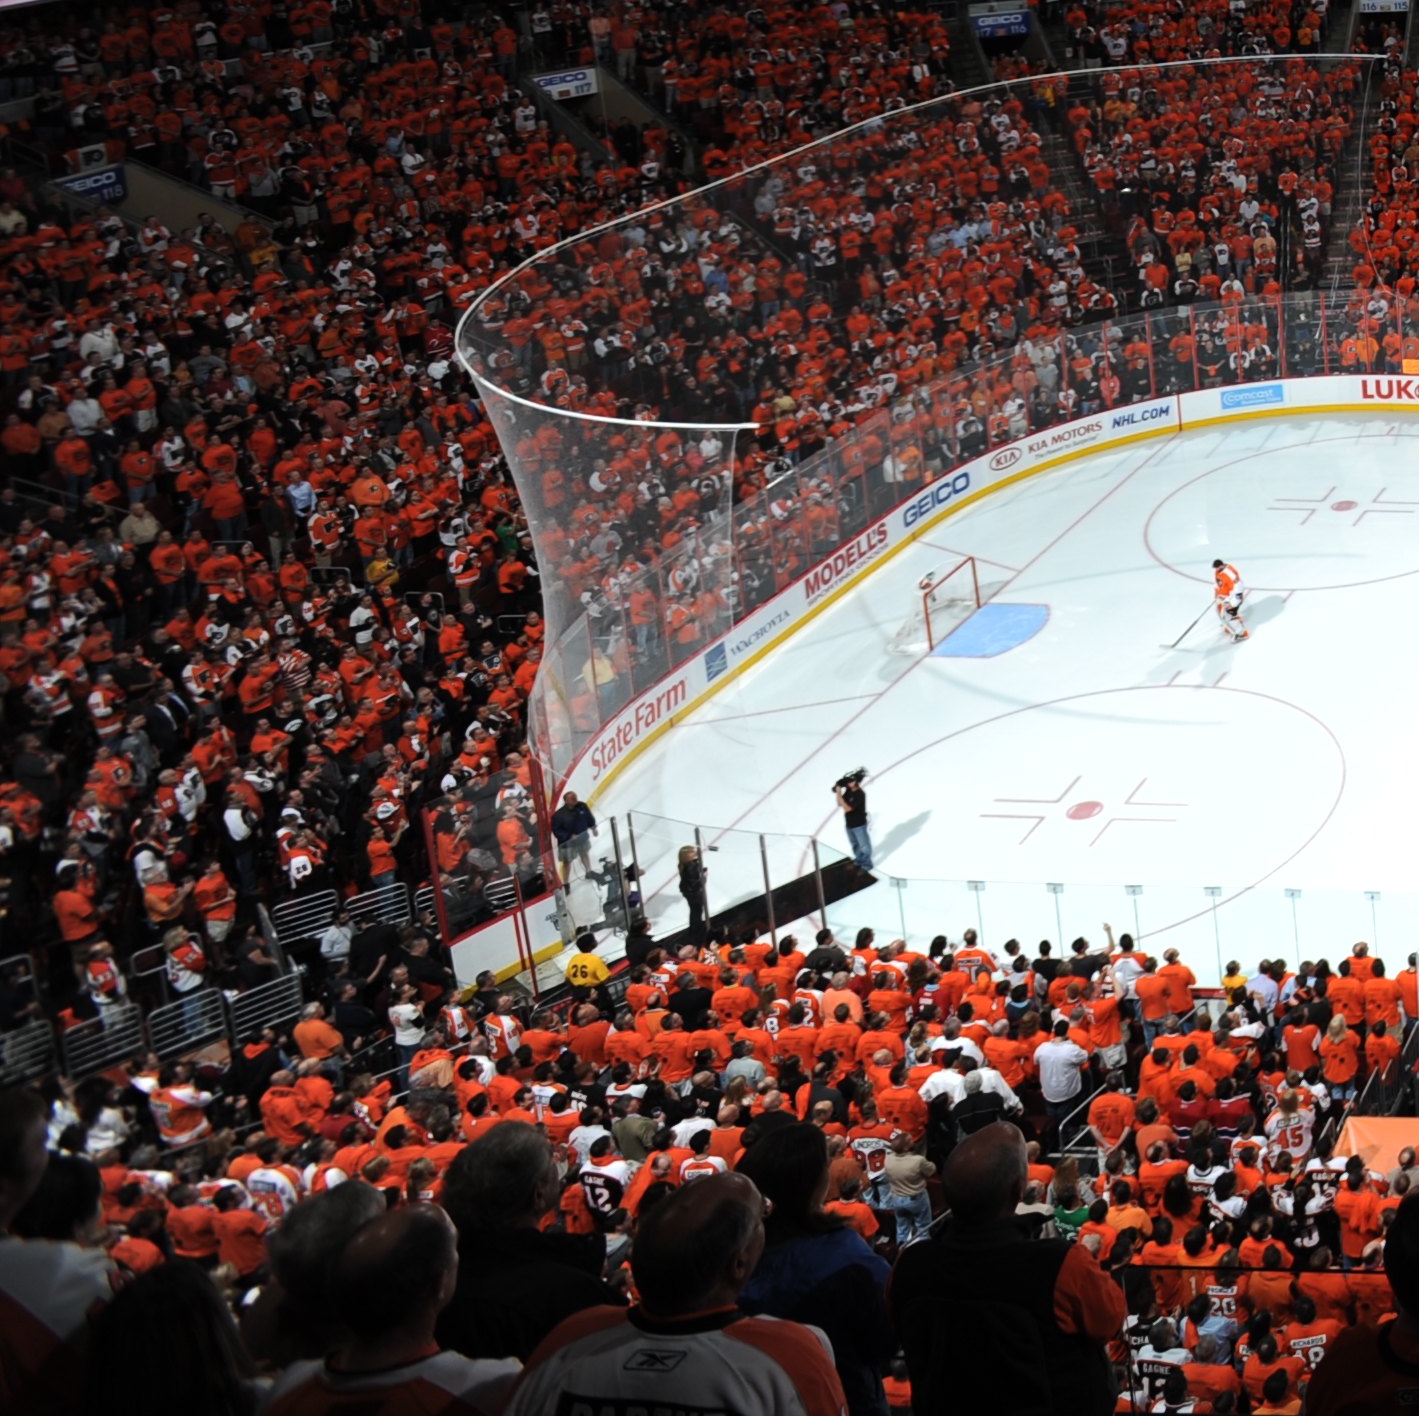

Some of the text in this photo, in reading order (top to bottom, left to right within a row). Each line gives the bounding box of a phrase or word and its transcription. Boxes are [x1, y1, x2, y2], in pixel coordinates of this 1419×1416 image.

[1363, 3, 1377, 11] 116
[977, 13, 1022, 26] GEICO
[1010, 24, 1027, 35] 116
[536, 72, 587, 88] GEICO
[574, 84, 592, 94] 117
[101, 186, 125, 202] 118
[1112, 405, 1170, 430] NHL.COM
[1028, 421, 1103, 455] KIA MOTORS
[994, 451, 1018, 467] KIA
[903, 471, 970, 528] GEICO
[804, 522, 888, 599] MODELL'S
[731, 609, 791, 656] WACHOVIA
[591, 679, 687, 781] State Farm
[571, 964, 589, 978] 26
[584, 1185, 612, 1212] 12
[1209, 1297, 1236, 1315] 20
[1290, 1334, 1327, 1349] RICHARDS
[1142, 1363, 1172, 1376] GAGNE
